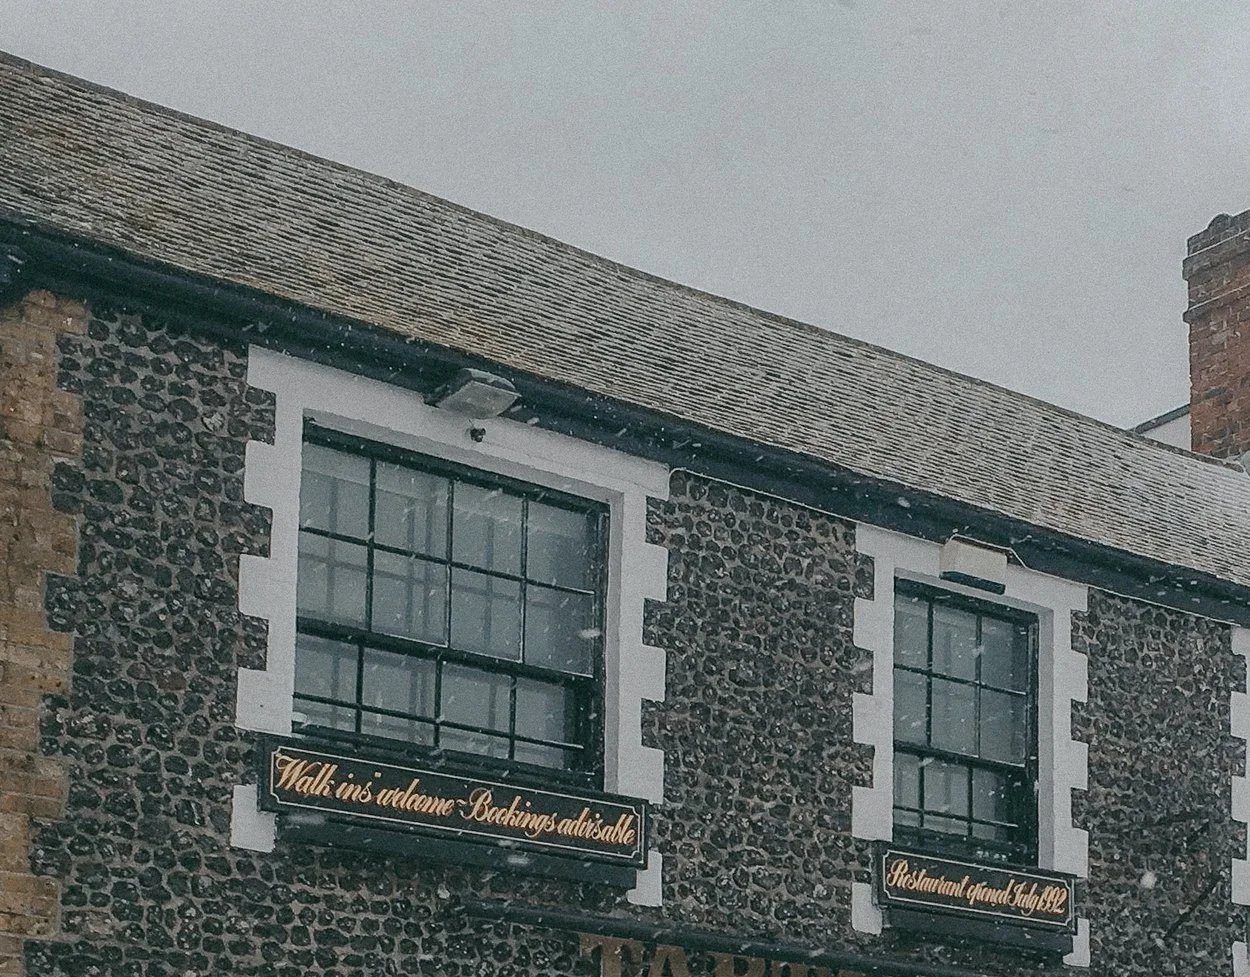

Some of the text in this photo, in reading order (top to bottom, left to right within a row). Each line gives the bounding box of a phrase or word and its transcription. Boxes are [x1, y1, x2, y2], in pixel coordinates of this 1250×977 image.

[275, 752, 335, 798] Walk
[377, 778, 455, 816] welcome
[460, 787, 557, 838] Bookings
[557, 807, 635, 845] advisable
[887, 859, 1067, 916] Restaurant opened July 1992
